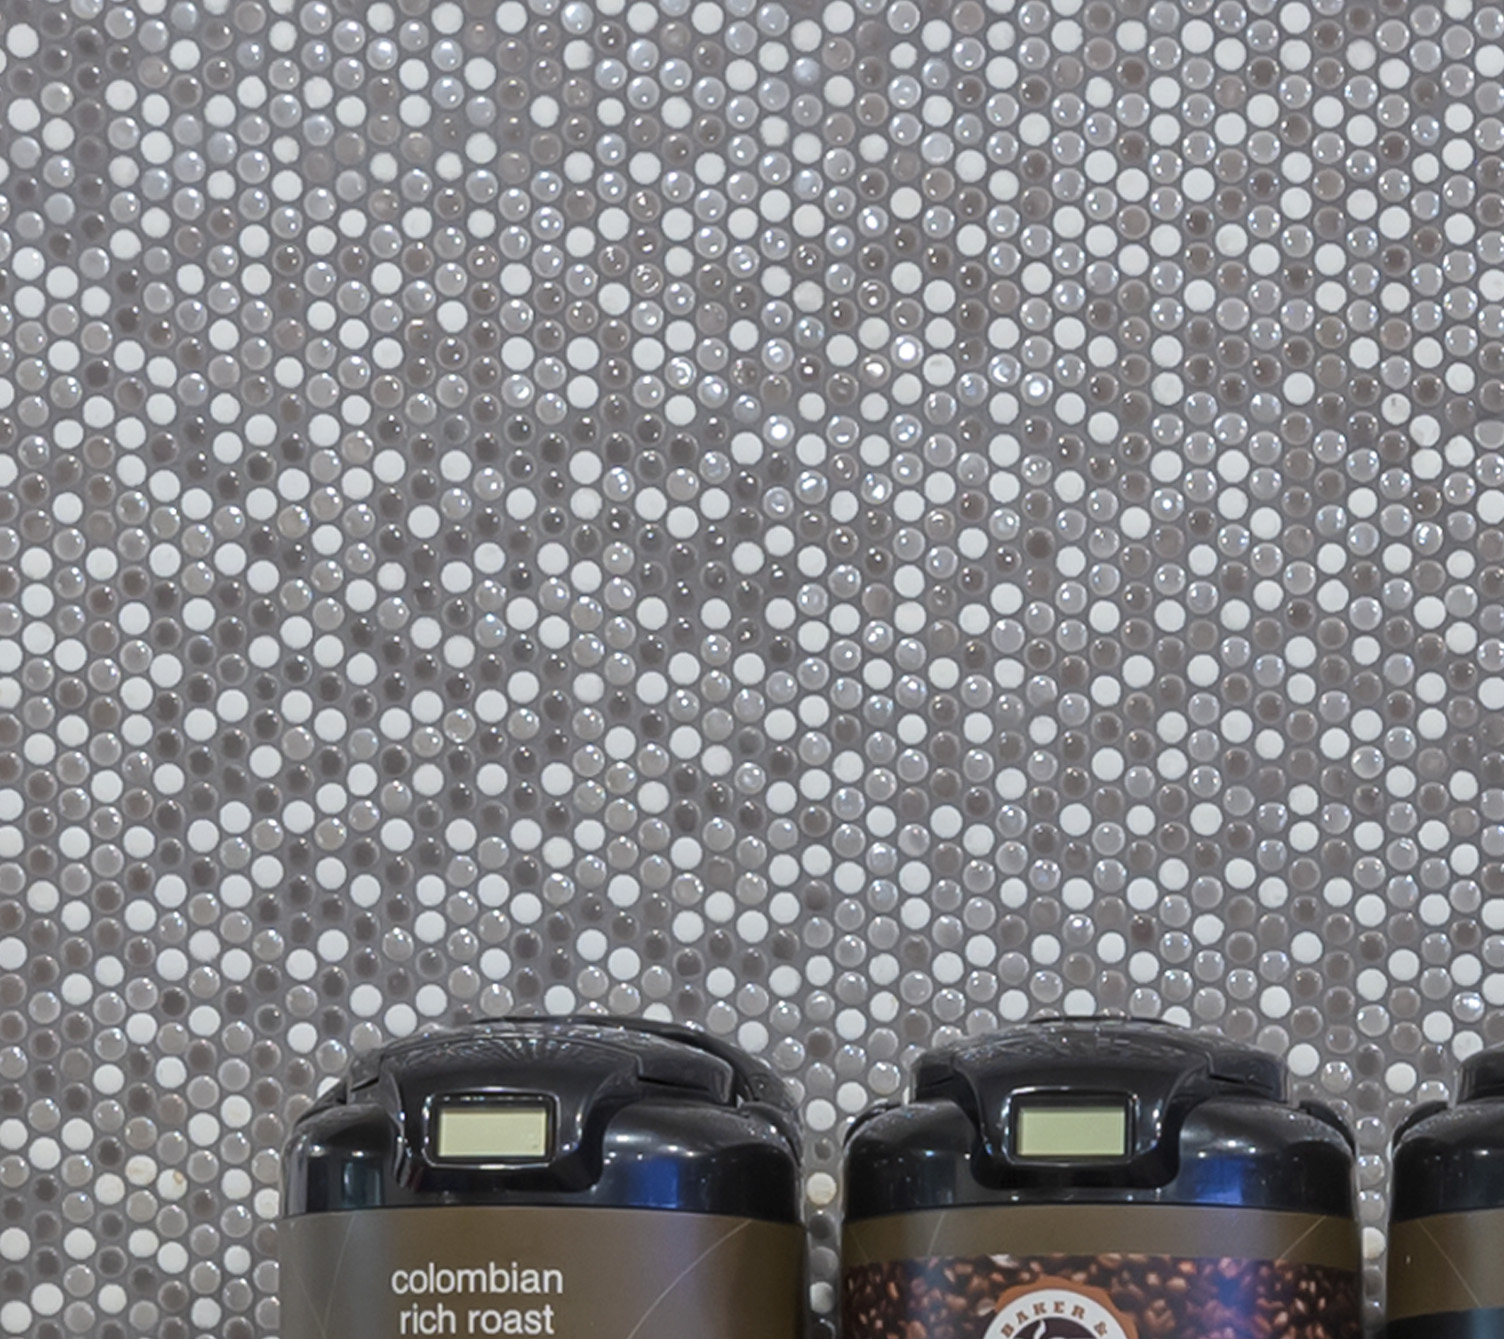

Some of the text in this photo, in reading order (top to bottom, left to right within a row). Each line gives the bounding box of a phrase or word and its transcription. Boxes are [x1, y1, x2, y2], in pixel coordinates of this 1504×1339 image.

[391, 1261, 563, 1294] colombian
[400, 1302, 555, 1335] rich roast
[1000, 1300, 1108, 1338] BAKER &
